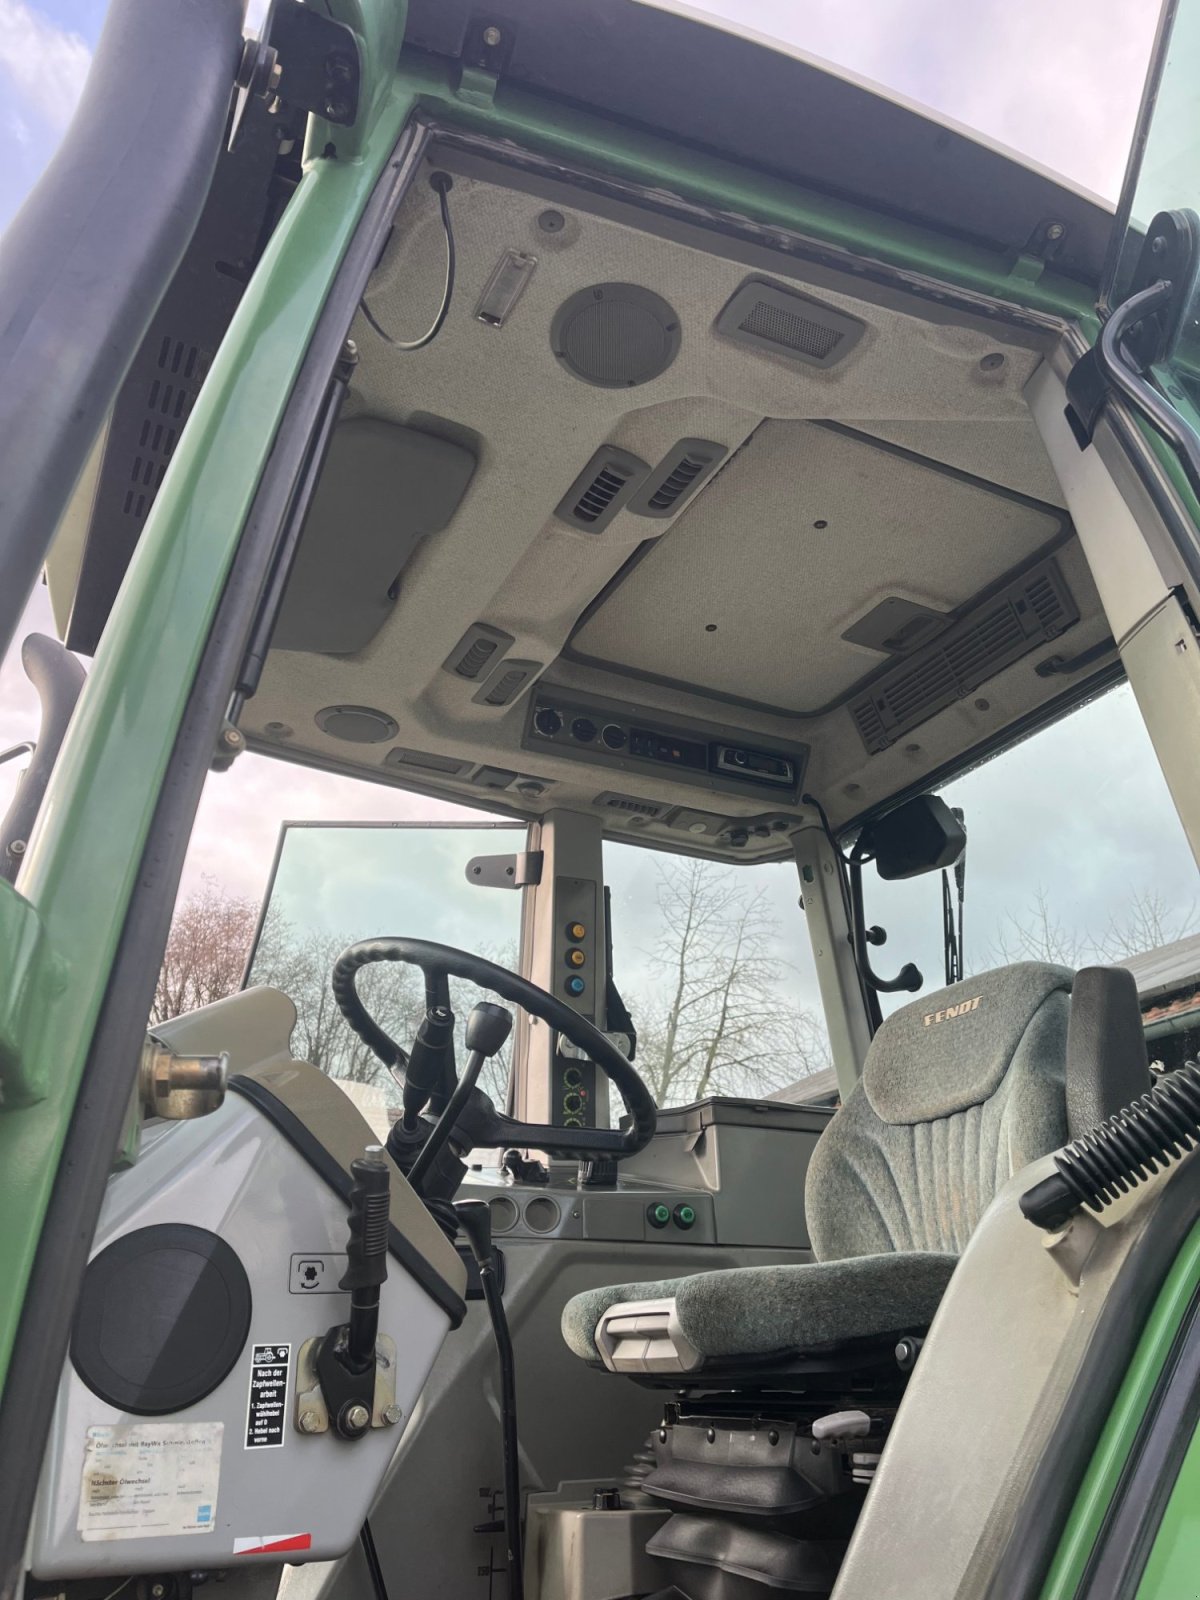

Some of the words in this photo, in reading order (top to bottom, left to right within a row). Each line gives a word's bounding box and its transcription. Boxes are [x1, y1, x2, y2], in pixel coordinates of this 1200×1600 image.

[923, 995, 984, 1027] FENDT
[257, 1369, 272, 1377] Nach
[273, 1369, 283, 1377] der
[252, 1379, 286, 1389] Zapfwellen-
[260, 1390, 277, 1398] arbeit
[256, 1401, 284, 1409] Zapfwellen-
[268, 1426, 280, 1434] nach
